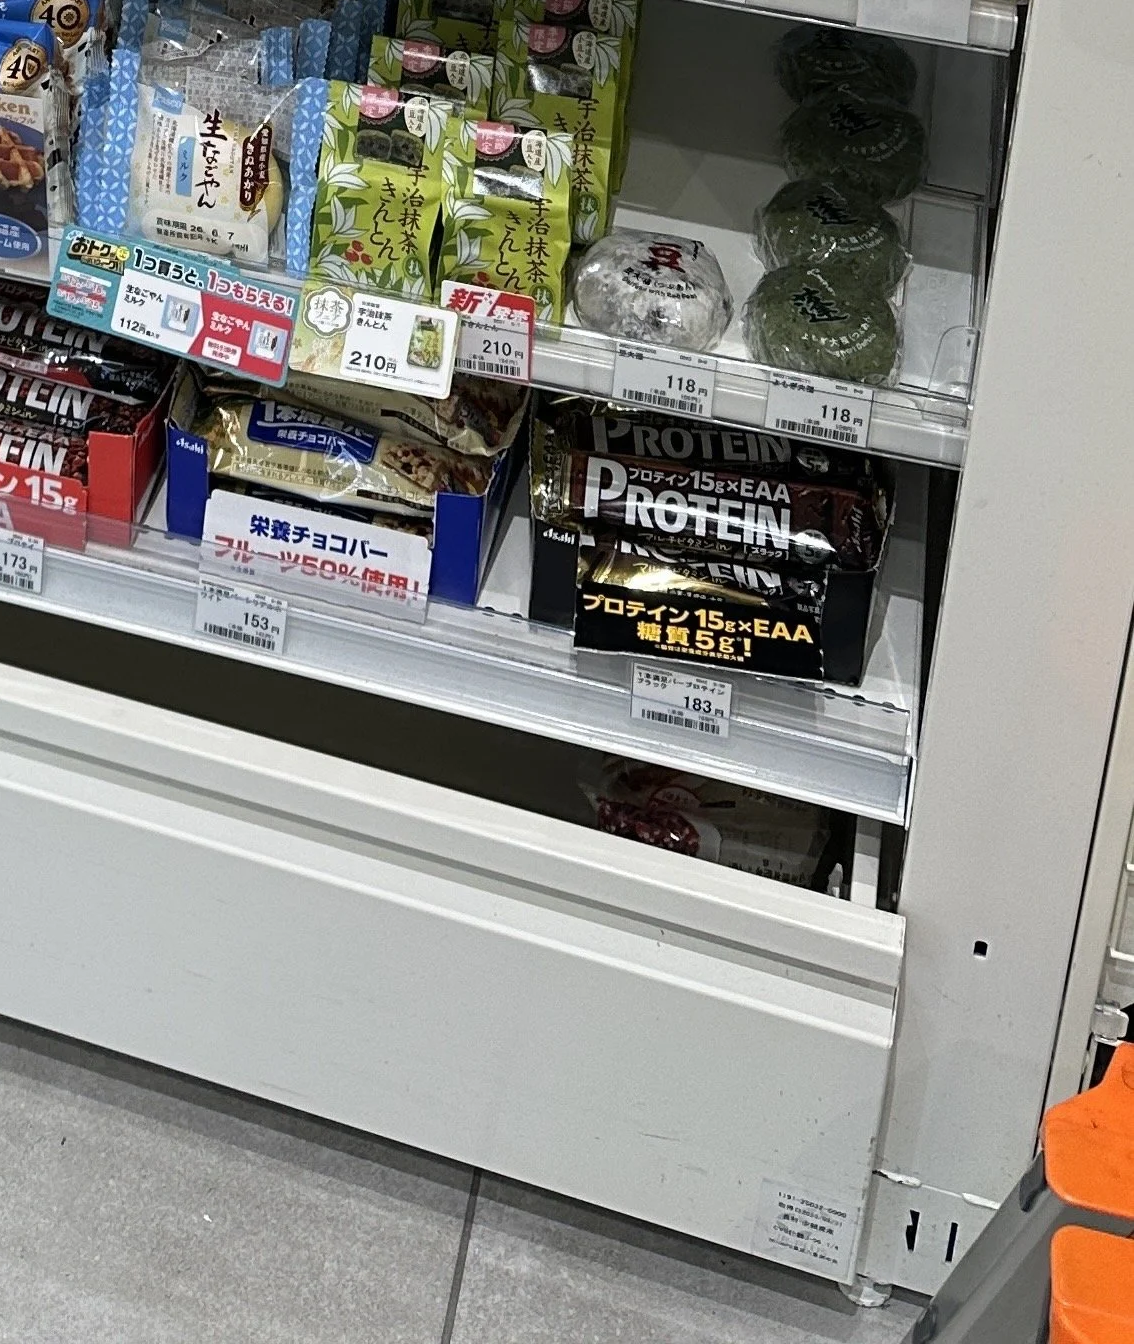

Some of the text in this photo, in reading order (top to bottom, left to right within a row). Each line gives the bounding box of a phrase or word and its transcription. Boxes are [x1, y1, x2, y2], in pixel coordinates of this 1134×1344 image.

[197, 109, 226, 208] 生なごやん
[369, 178, 400, 262] きんとん
[399, 163, 426, 255] 宇治抹茶
[134, 247, 292, 315] 1つ買うと、 1つもらえる!
[119, 317, 147, 334] 112円
[483, 339, 524, 359] 210円
[350, 350, 396, 374] 210円
[667, 374, 708, 395] 118円
[23, 475, 78, 515] 15g
[584, 456, 791, 551] PROTEIN
[250, 514, 387, 560] 栄養チョコバー
[214, 535, 420, 601] フルーツ50%使用!
[582, 593, 813, 644] プロテイン 15g×EAA
[683, 696, 724, 718] 183円
